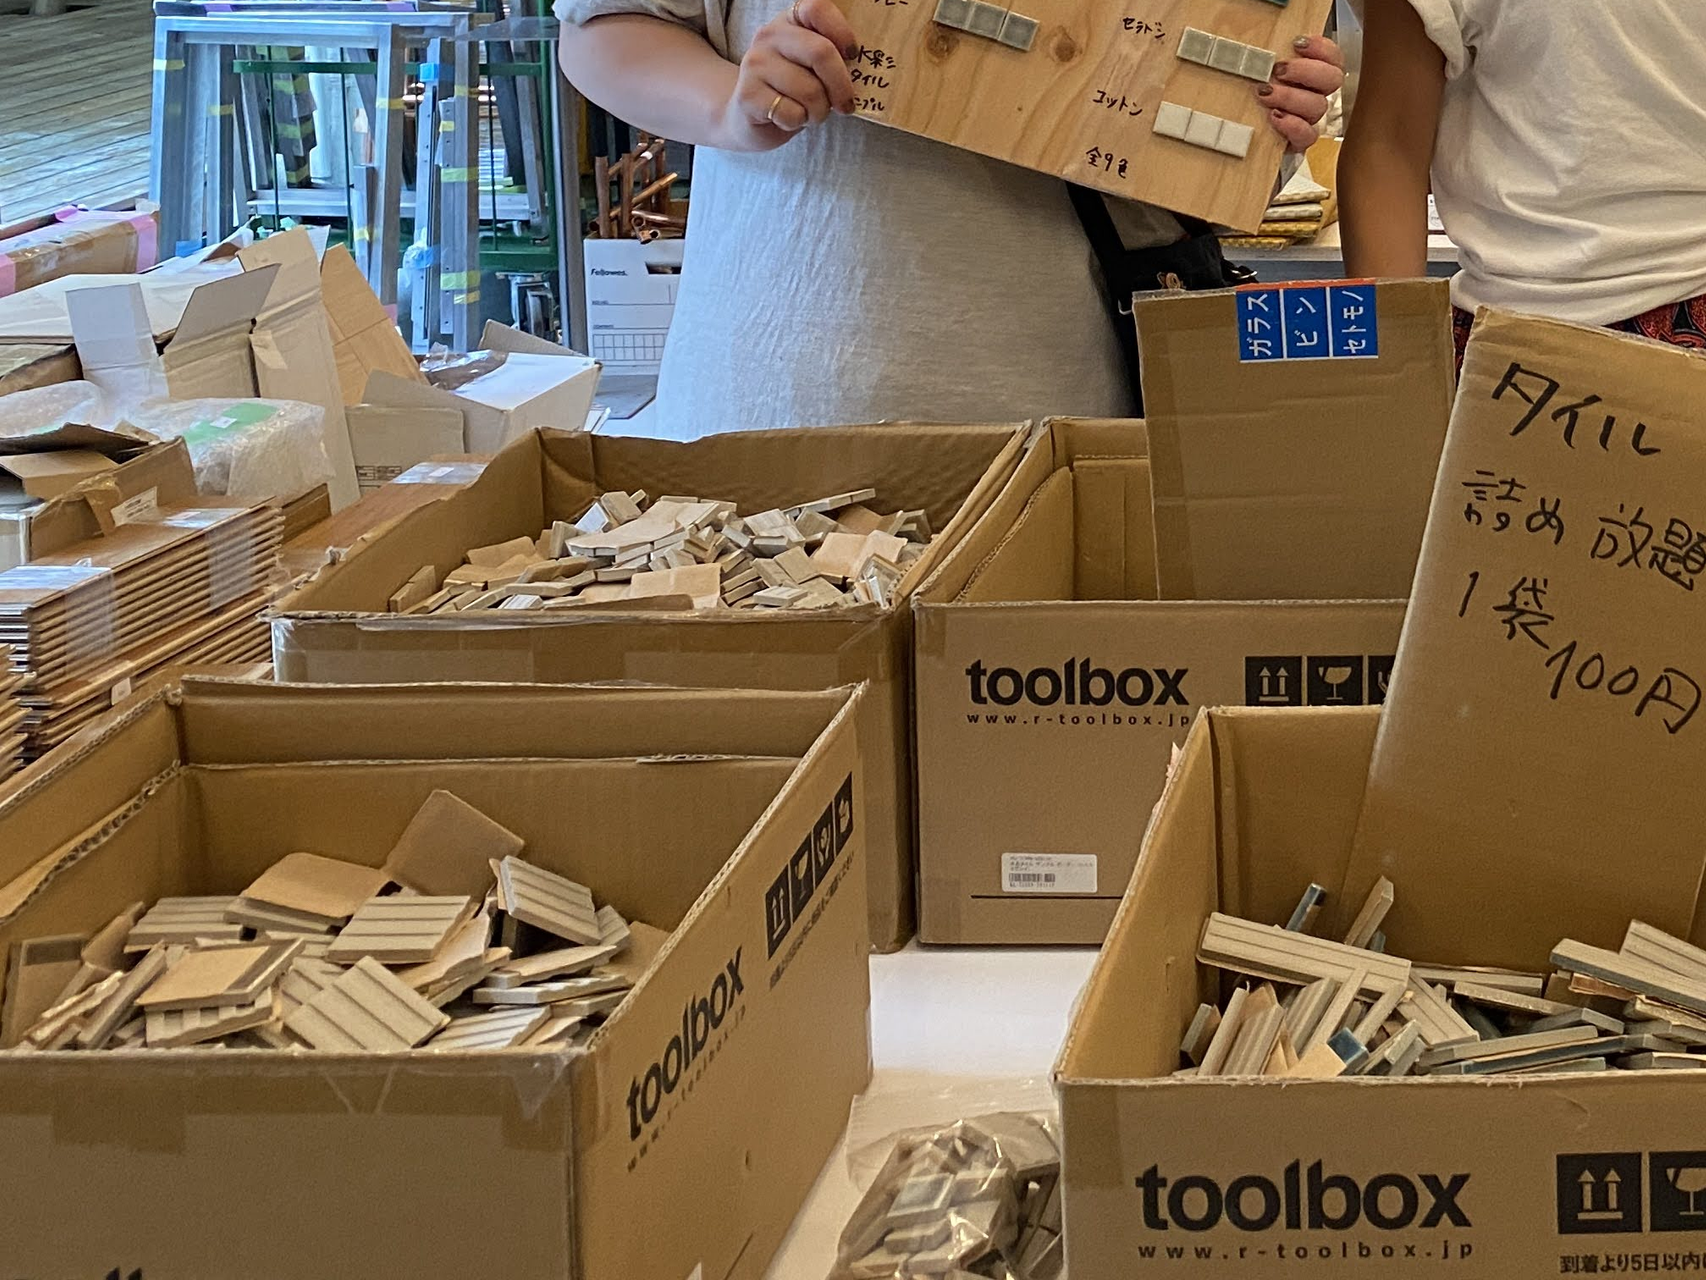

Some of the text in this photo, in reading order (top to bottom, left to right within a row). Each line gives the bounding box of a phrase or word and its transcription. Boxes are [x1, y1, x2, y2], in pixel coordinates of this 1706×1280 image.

[1092, 89, 1143, 117] コットン
[1246, 293, 1272, 357] ガラス
[1294, 296, 1318, 347] ビン
[1341, 290, 1367, 354] セトモノ
[1491, 363, 1661, 456] タイル
[965, 656, 1190, 706] toolbox
[966, 712, 1191, 727] www.r-toolbox.jp
[626, 945, 744, 1142] toolbox
[1135, 1157, 1473, 1233] toolbox
[1138, 1240, 1474, 1261] www.r-toolbox.jp
